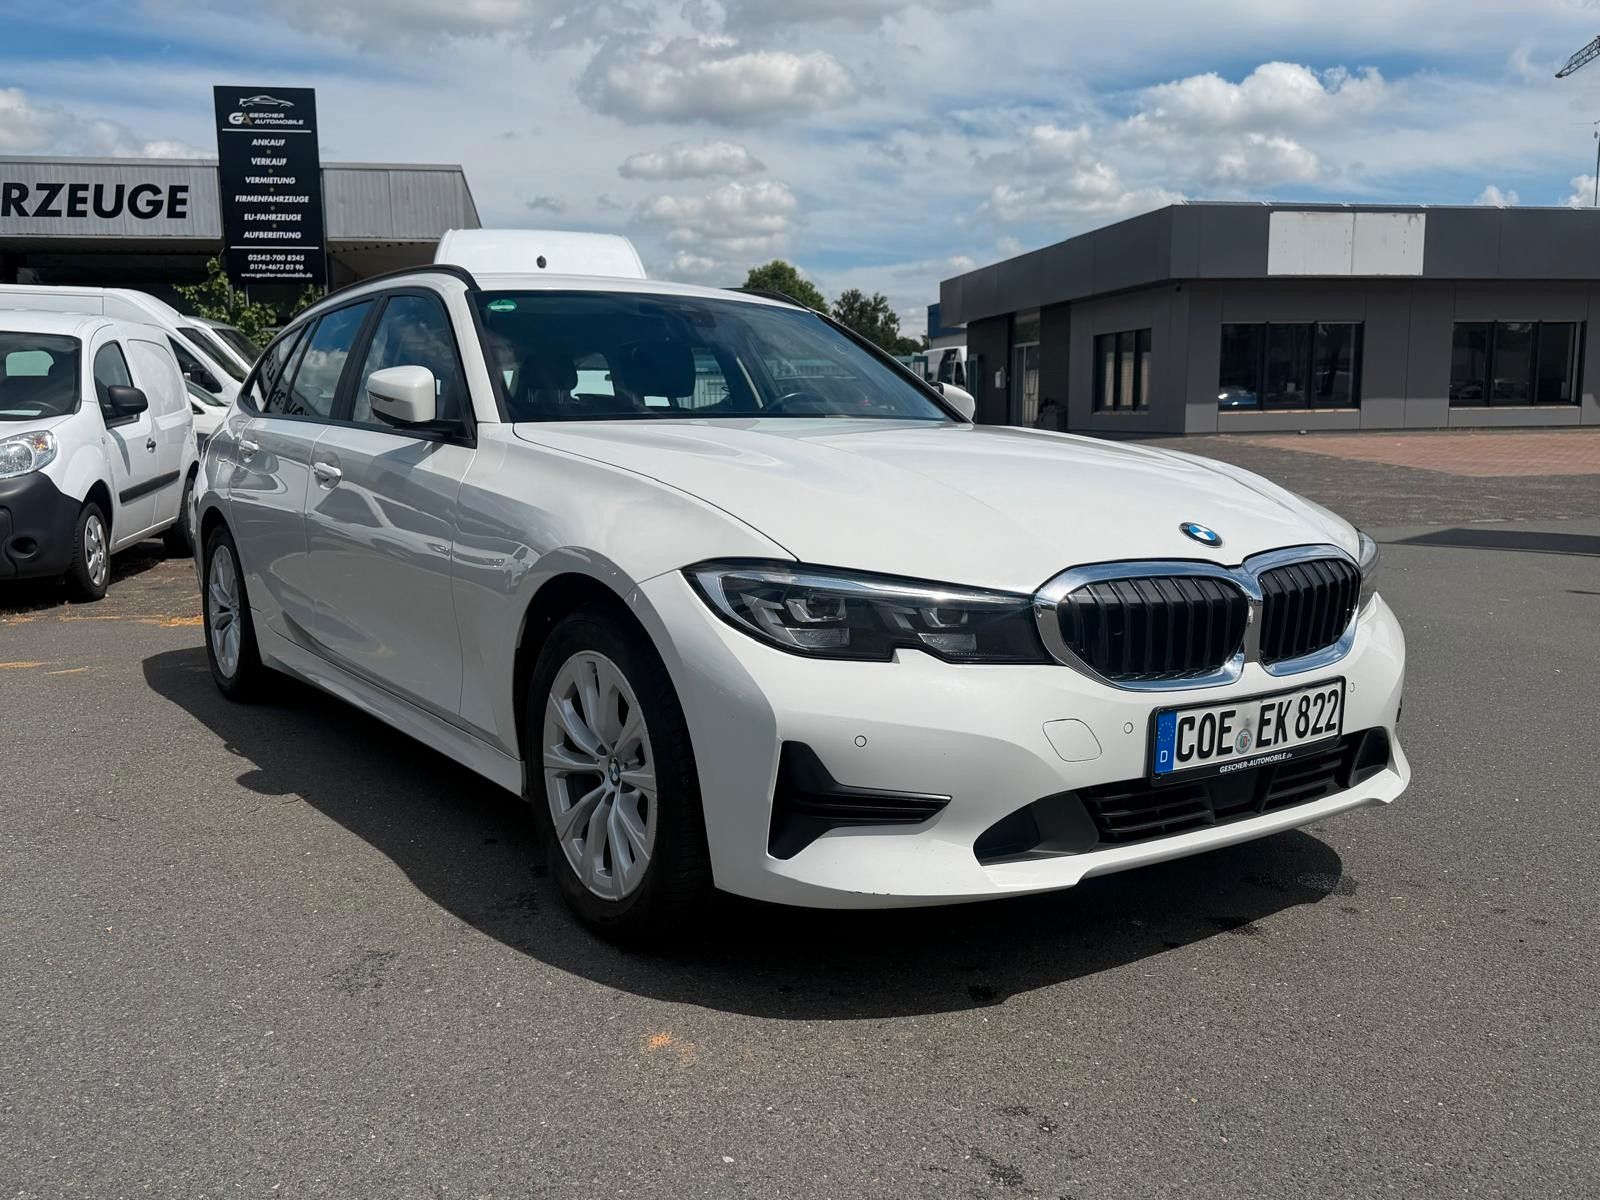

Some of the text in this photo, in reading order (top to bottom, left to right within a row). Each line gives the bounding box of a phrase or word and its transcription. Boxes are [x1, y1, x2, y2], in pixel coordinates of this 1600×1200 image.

[251, 157, 287, 166] VERKAUF
[245, 176, 296, 184] VERMIETUNG
[1, 183, 189, 219] RZEUGE
[235, 195, 309, 203] FIRMENFAHRZEUGE
[244, 213, 302, 221] EU-FAHRZEUGE
[243, 231, 302, 239] AUFBEREITUNG
[1159, 689, 1339, 763] D COE EK 822
